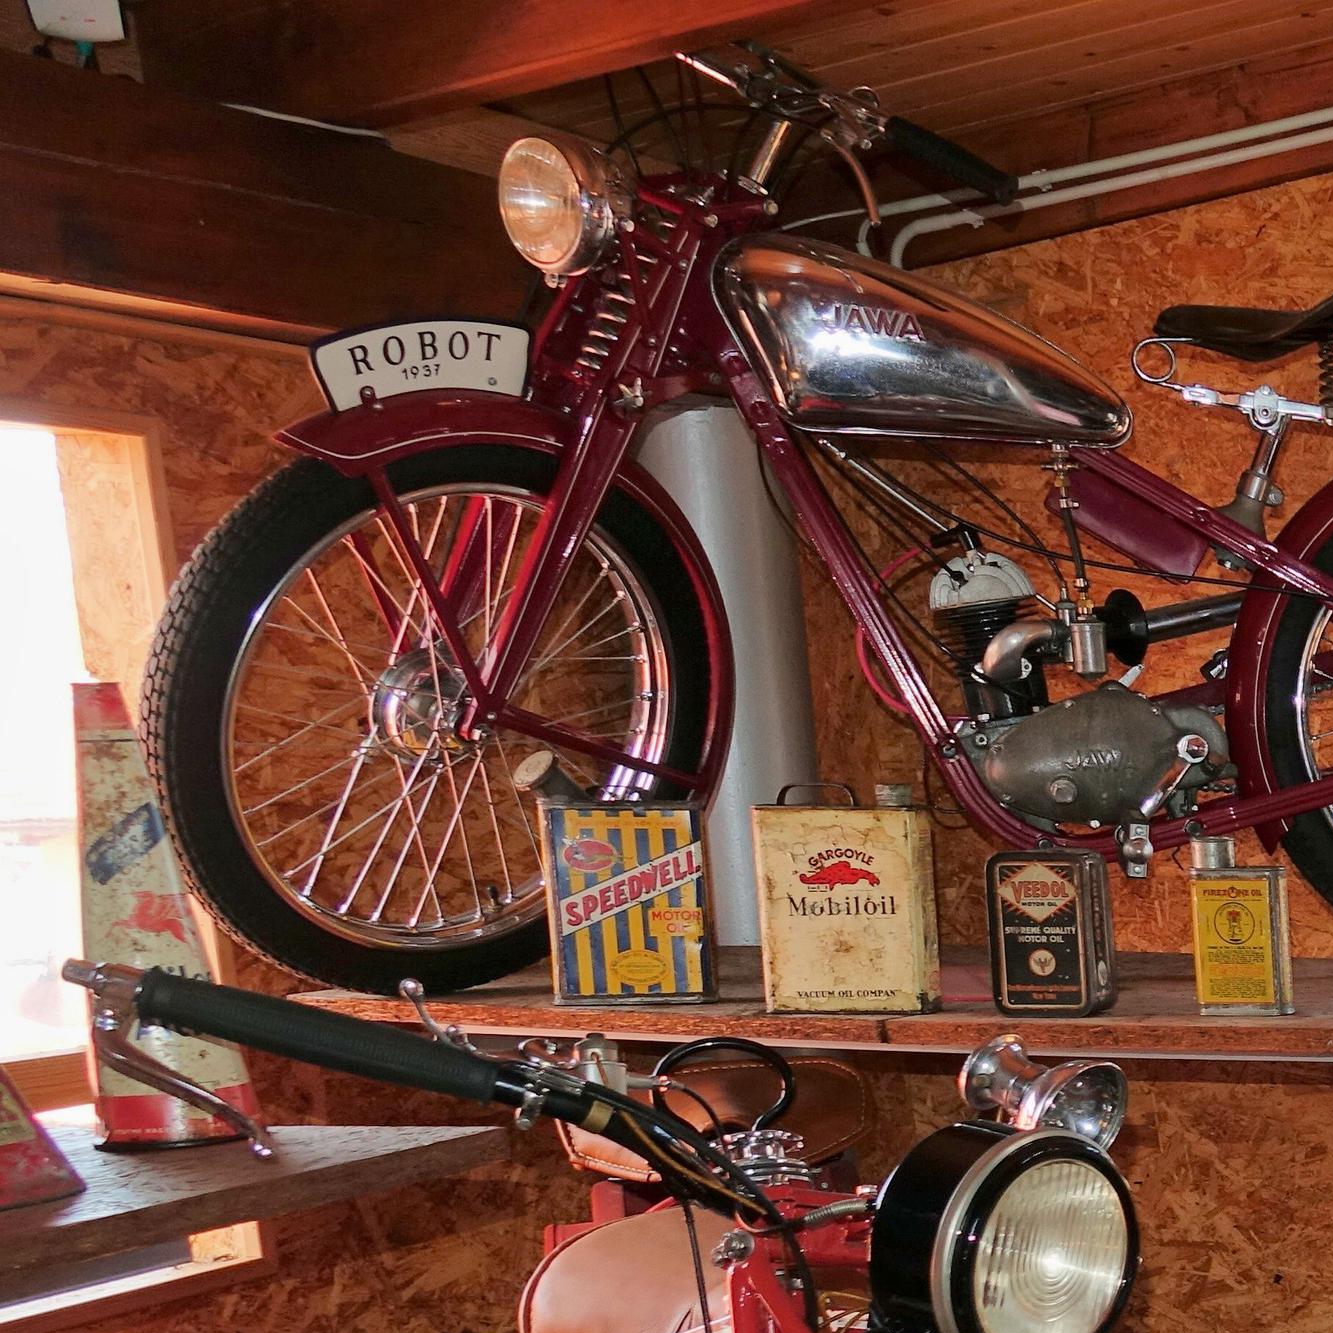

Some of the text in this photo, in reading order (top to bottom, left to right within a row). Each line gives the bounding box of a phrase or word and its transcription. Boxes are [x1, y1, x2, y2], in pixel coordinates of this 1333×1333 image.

[822, 304, 926, 342] JAWA
[347, 330, 501, 376] ROBOT
[402, 364, 440, 381] 1937
[808, 848, 875, 867] GARGOYLE
[1012, 880, 1069, 903] VEEDOL
[651, 910, 701, 921] MOTOR
[788, 896, 897, 917] Mobiloil
[1043, 926, 1076, 935] QUALITY
[1049, 935, 1064, 943] OIL
[797, 989, 900, 998] VACUUM OIL COMPAN
